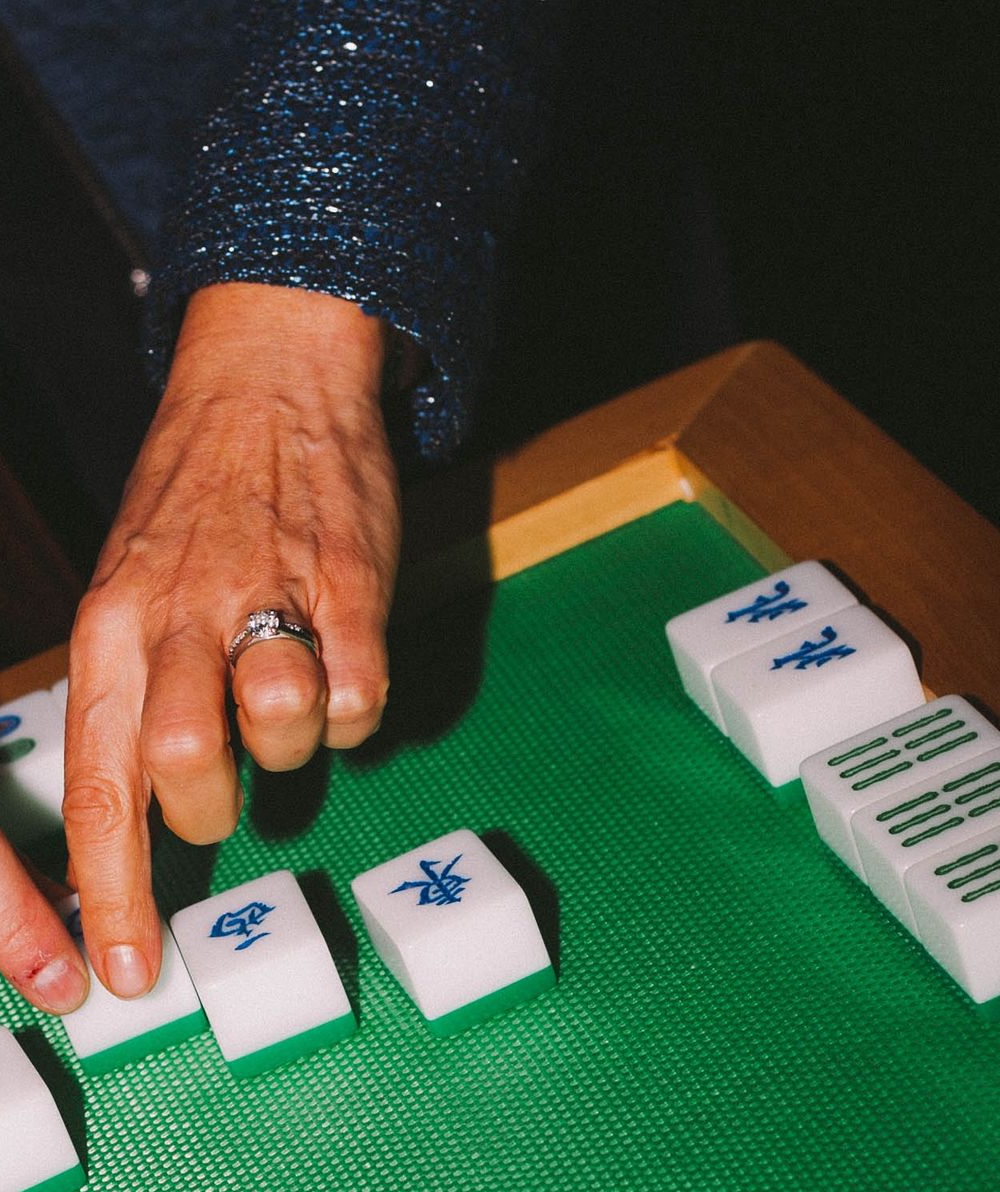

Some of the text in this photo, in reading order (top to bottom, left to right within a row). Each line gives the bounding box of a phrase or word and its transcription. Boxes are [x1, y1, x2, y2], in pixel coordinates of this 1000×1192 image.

[727, 580, 807, 623] 北
[772, 625, 856, 670] 北
[388, 853, 472, 906] 東
[209, 901, 275, 951] 西
